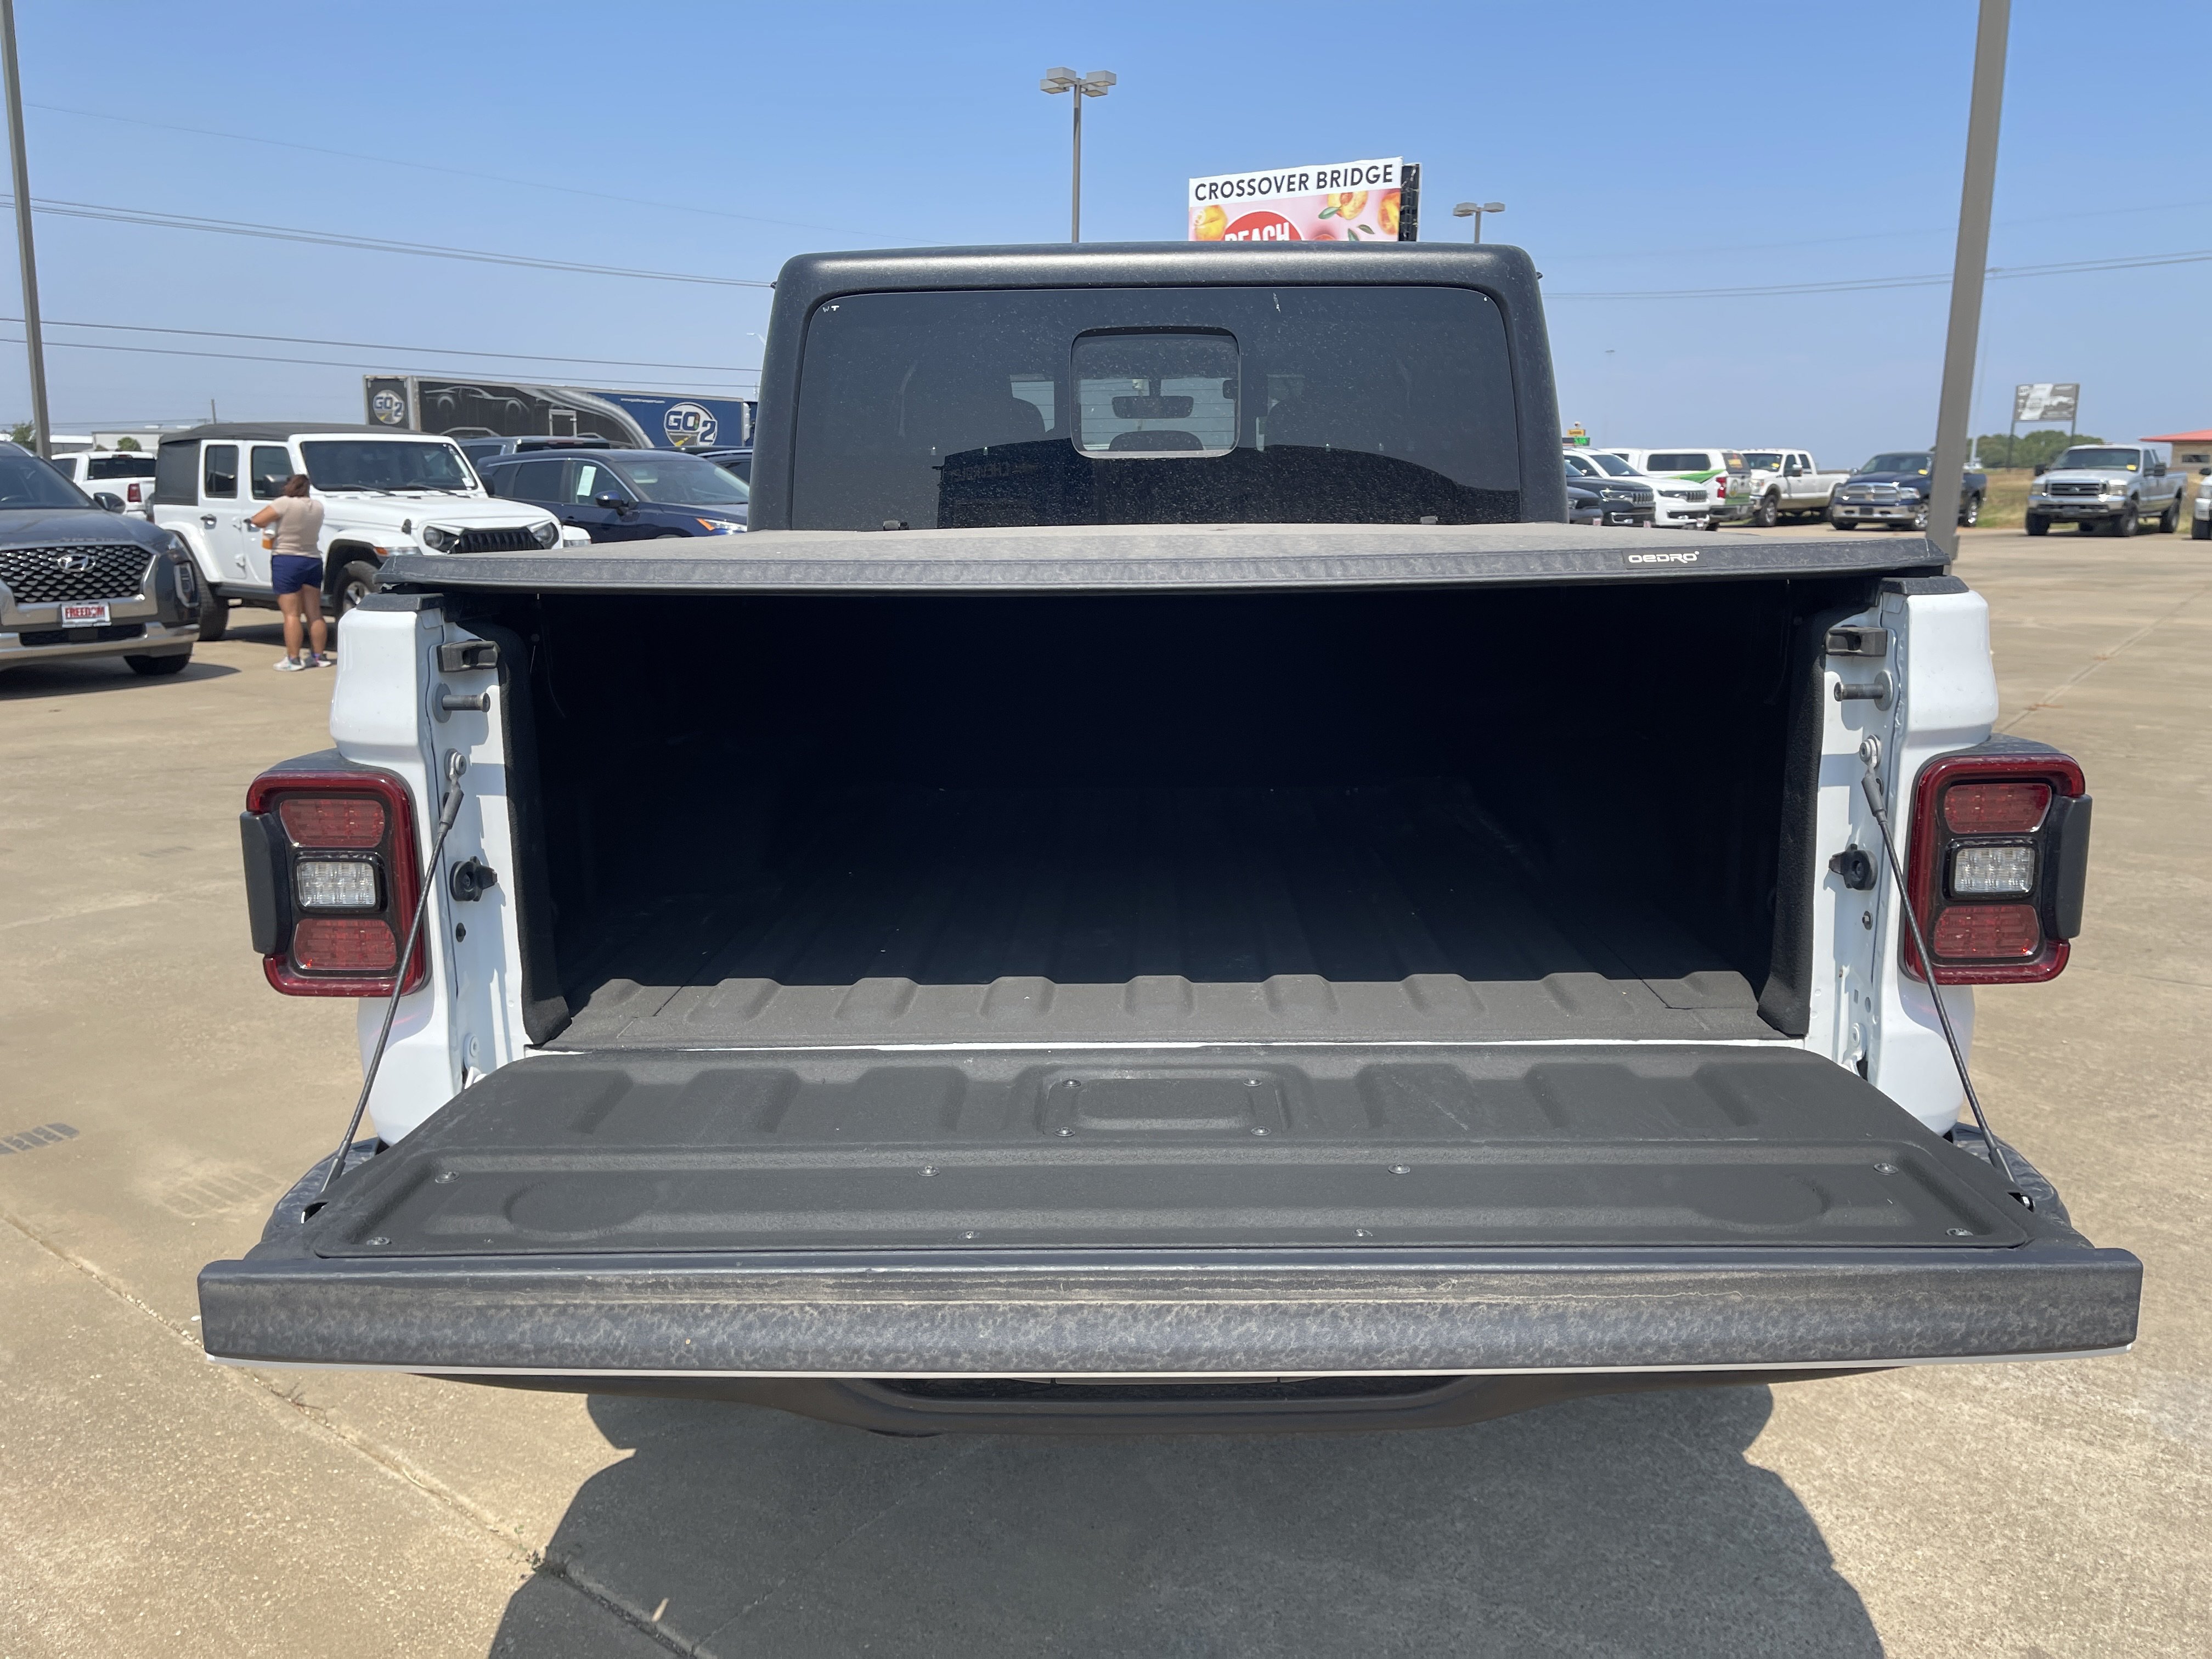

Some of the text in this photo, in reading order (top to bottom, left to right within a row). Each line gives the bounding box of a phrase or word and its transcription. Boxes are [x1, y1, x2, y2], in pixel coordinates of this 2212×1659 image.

[1195, 164, 1393, 201] CROSSOVER BRIDGE
[1224, 222, 1290, 241] ACH
